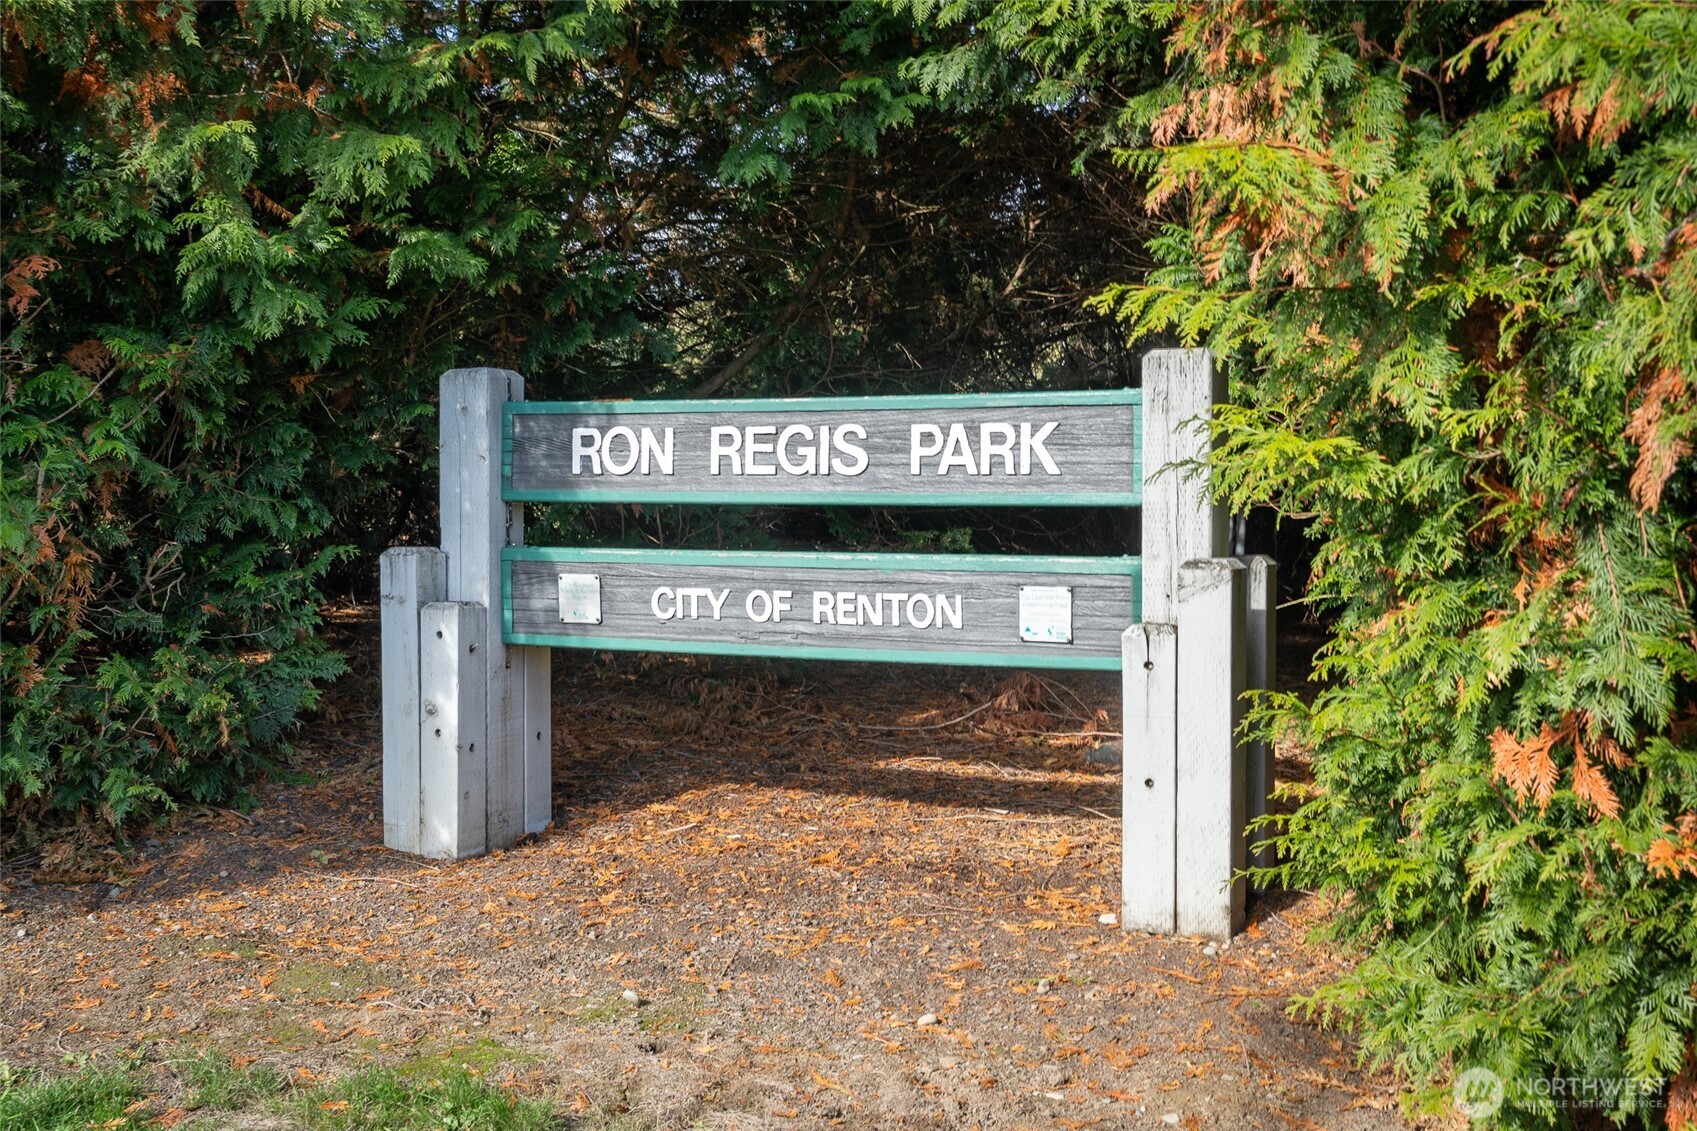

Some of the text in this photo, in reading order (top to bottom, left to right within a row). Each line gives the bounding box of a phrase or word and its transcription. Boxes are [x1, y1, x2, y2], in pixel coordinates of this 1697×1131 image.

[571, 420, 1062, 477] RON REGIS PARK
[650, 586, 963, 630] CITY OF RENTON
